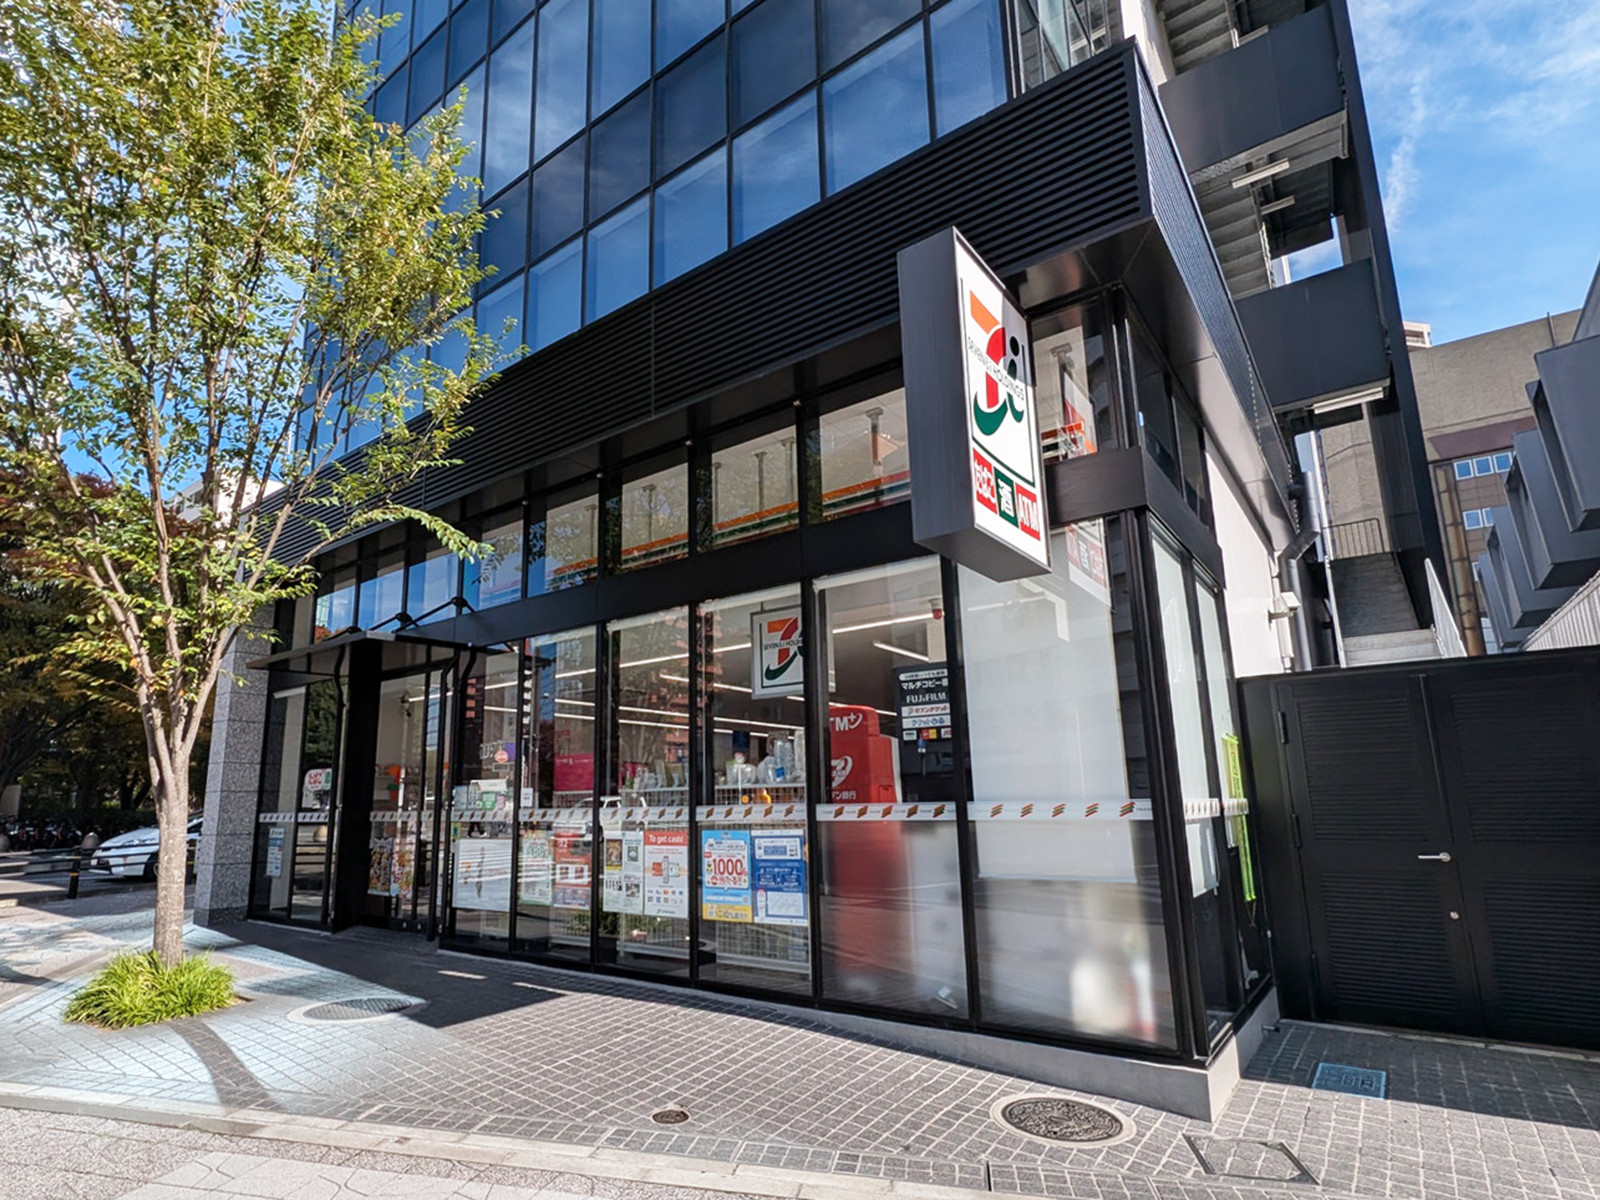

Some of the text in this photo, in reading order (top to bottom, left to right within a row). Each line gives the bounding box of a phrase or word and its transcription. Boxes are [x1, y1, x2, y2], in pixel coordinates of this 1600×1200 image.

[974, 459, 1015, 517] たばこ 酒
[1018, 492, 1040, 532] ATM
[649, 834, 656, 843] To
[657, 835, 667, 845] get
[712, 858, 744, 876] 1000
